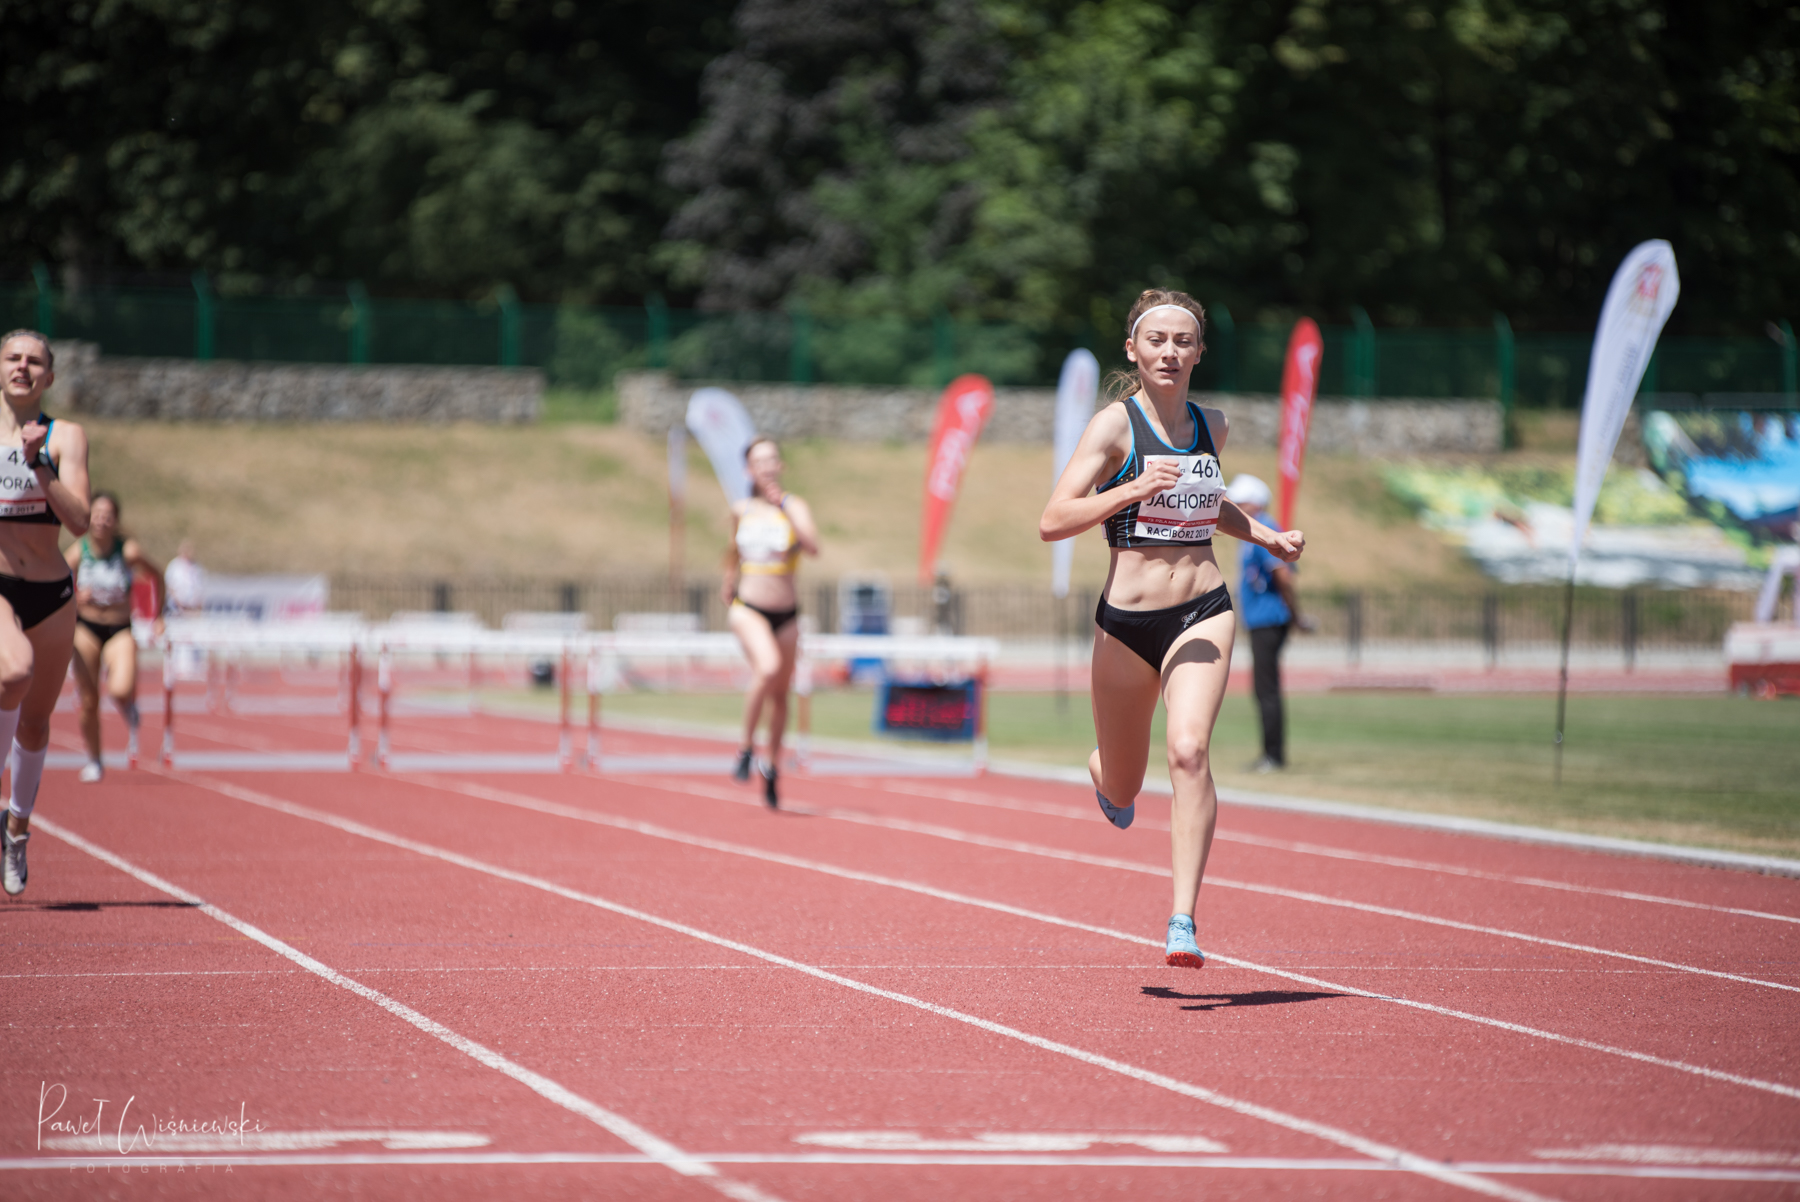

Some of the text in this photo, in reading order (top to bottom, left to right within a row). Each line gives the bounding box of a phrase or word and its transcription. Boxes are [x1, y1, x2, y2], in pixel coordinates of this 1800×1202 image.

[1147, 493, 1221, 510] JACHOREK
[1147, 526, 1209, 539] RACIBÓRZ 2019
